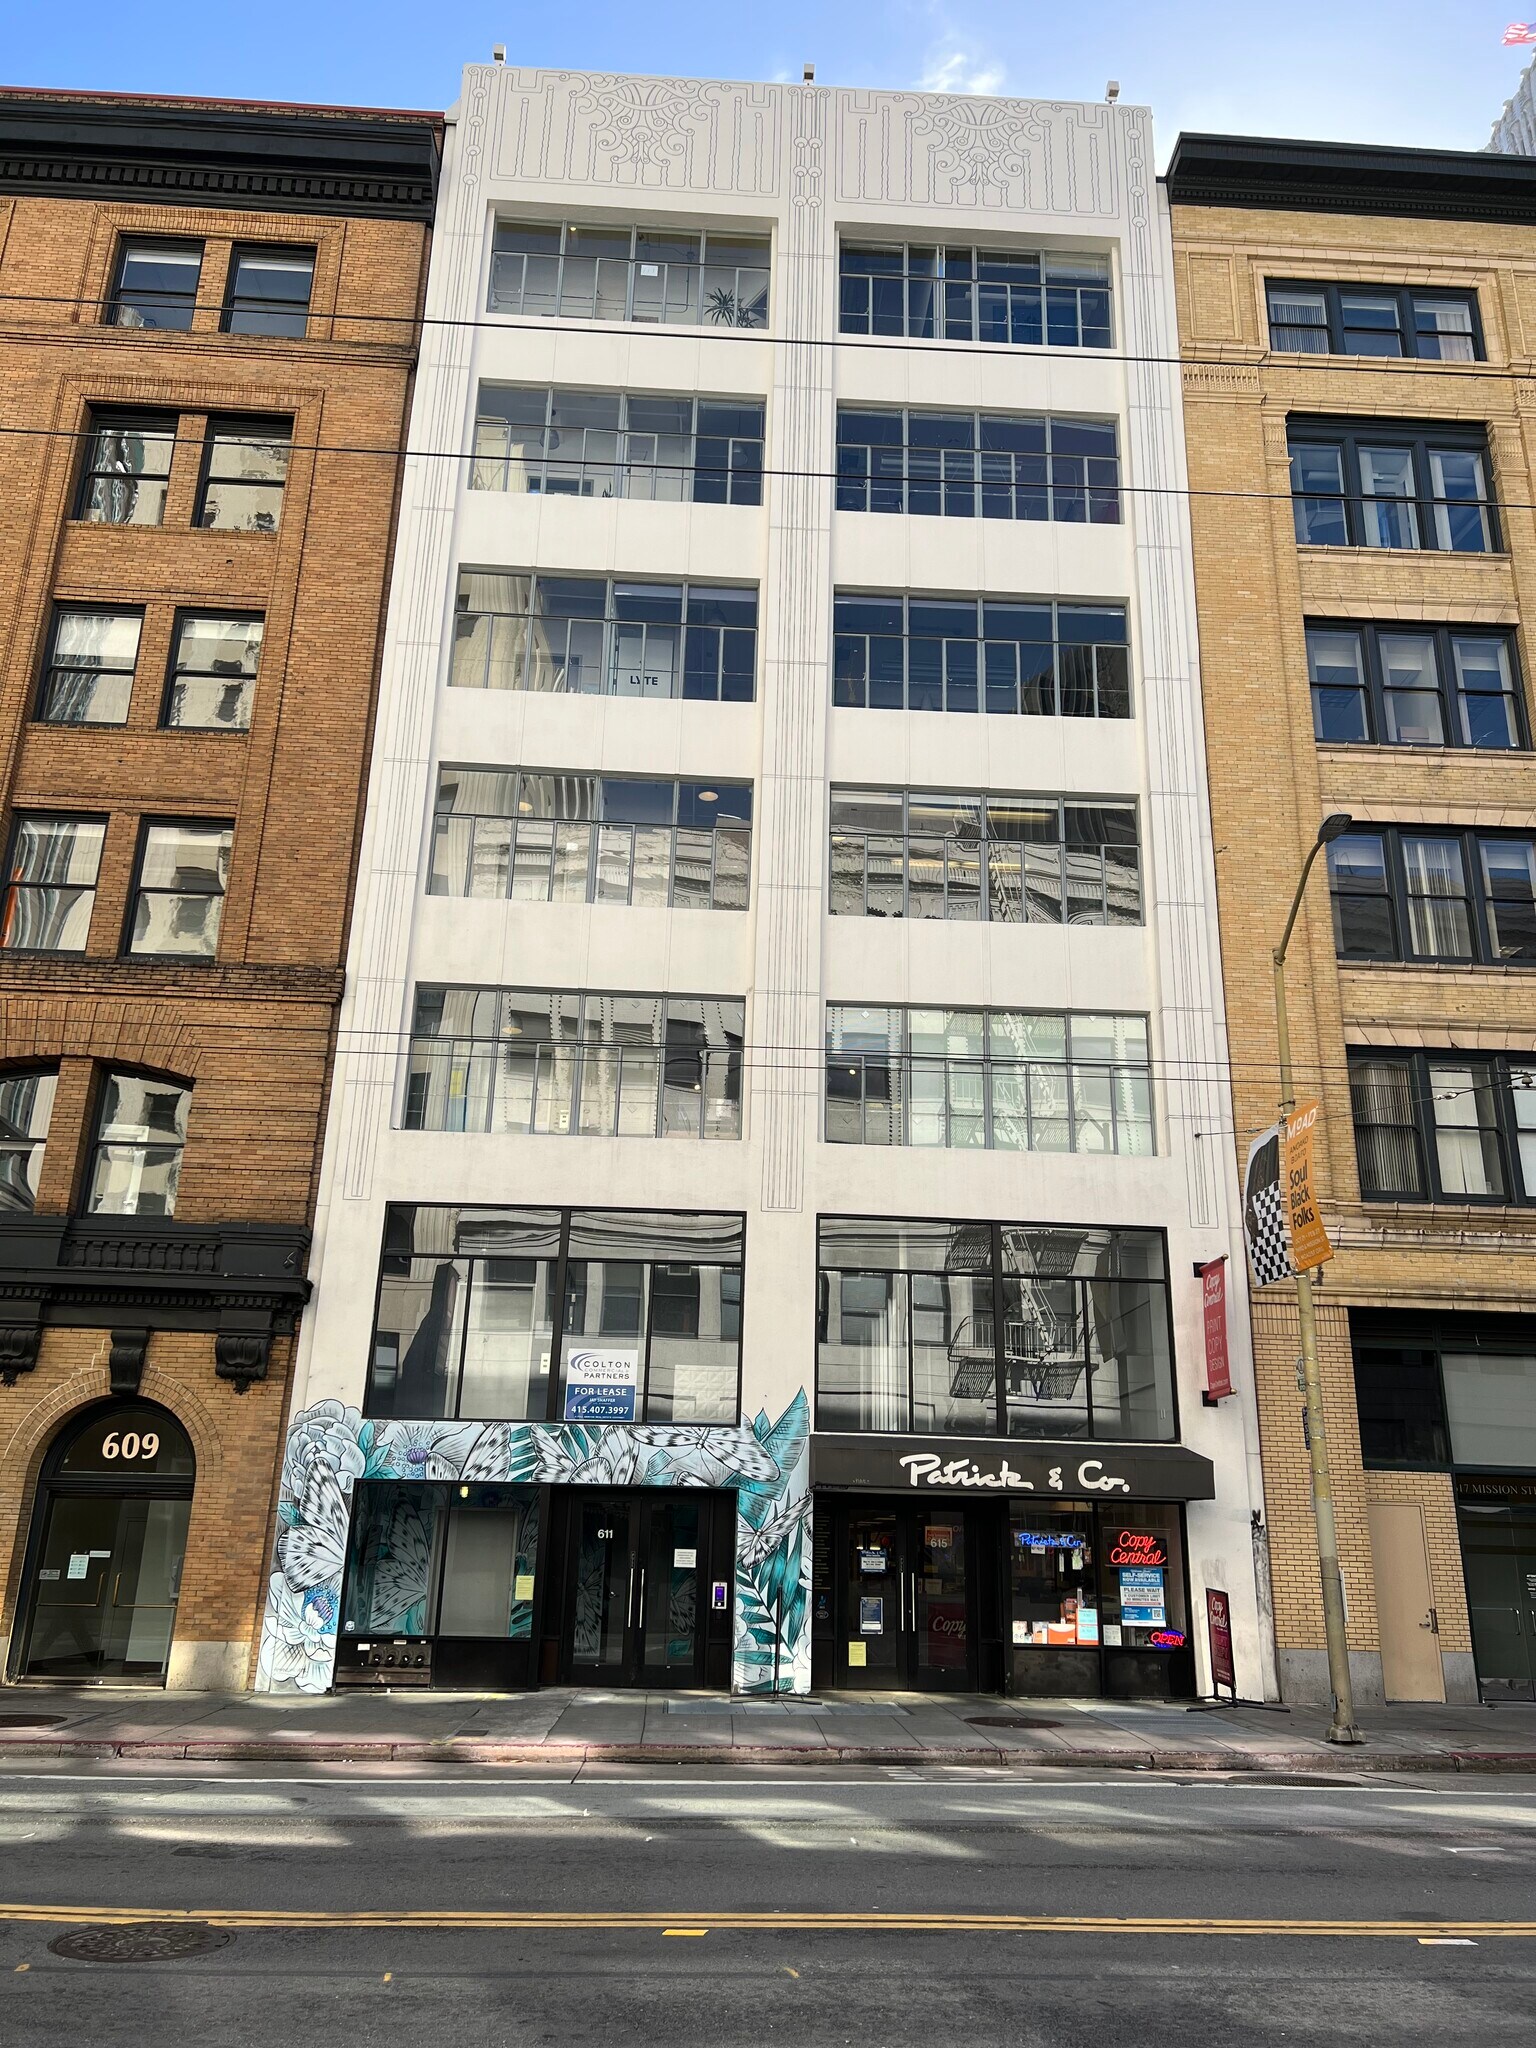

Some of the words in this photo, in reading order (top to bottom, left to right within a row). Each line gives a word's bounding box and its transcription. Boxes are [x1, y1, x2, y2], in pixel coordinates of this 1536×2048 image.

[1289, 1160, 1308, 1190] Soul
[1290, 1185, 1311, 1210] Black
[1292, 1206, 1315, 1231] Folks
[1206, 1274, 1220, 1292] Copy
[1207, 1315, 1222, 1335] PRINT
[1208, 1336, 1223, 1355] COPY
[1208, 1355, 1225, 1372] DESIGN
[574, 1387, 595, 1395] FOR
[597, 1387, 628, 1396] LEASE
[571, 1405, 629, 1415] 415.407.3997
[102, 1432, 160, 1460] 609
[899, 1453, 1034, 1490] Patrick
[1048, 1466, 1064, 1491] &
[1077, 1460, 1131, 1493] Co.
[1456, 1483, 1469, 1493] 17
[1472, 1484, 1518, 1494] MISSION
[597, 1529, 614, 1539] 611
[930, 1538, 948, 1548] 615
[1119, 1531, 1157, 1553] Copy
[1110, 1547, 1167, 1565] Central
[932, 1615, 966, 1636] Copy
[1150, 1631, 1185, 1647] OPEN
